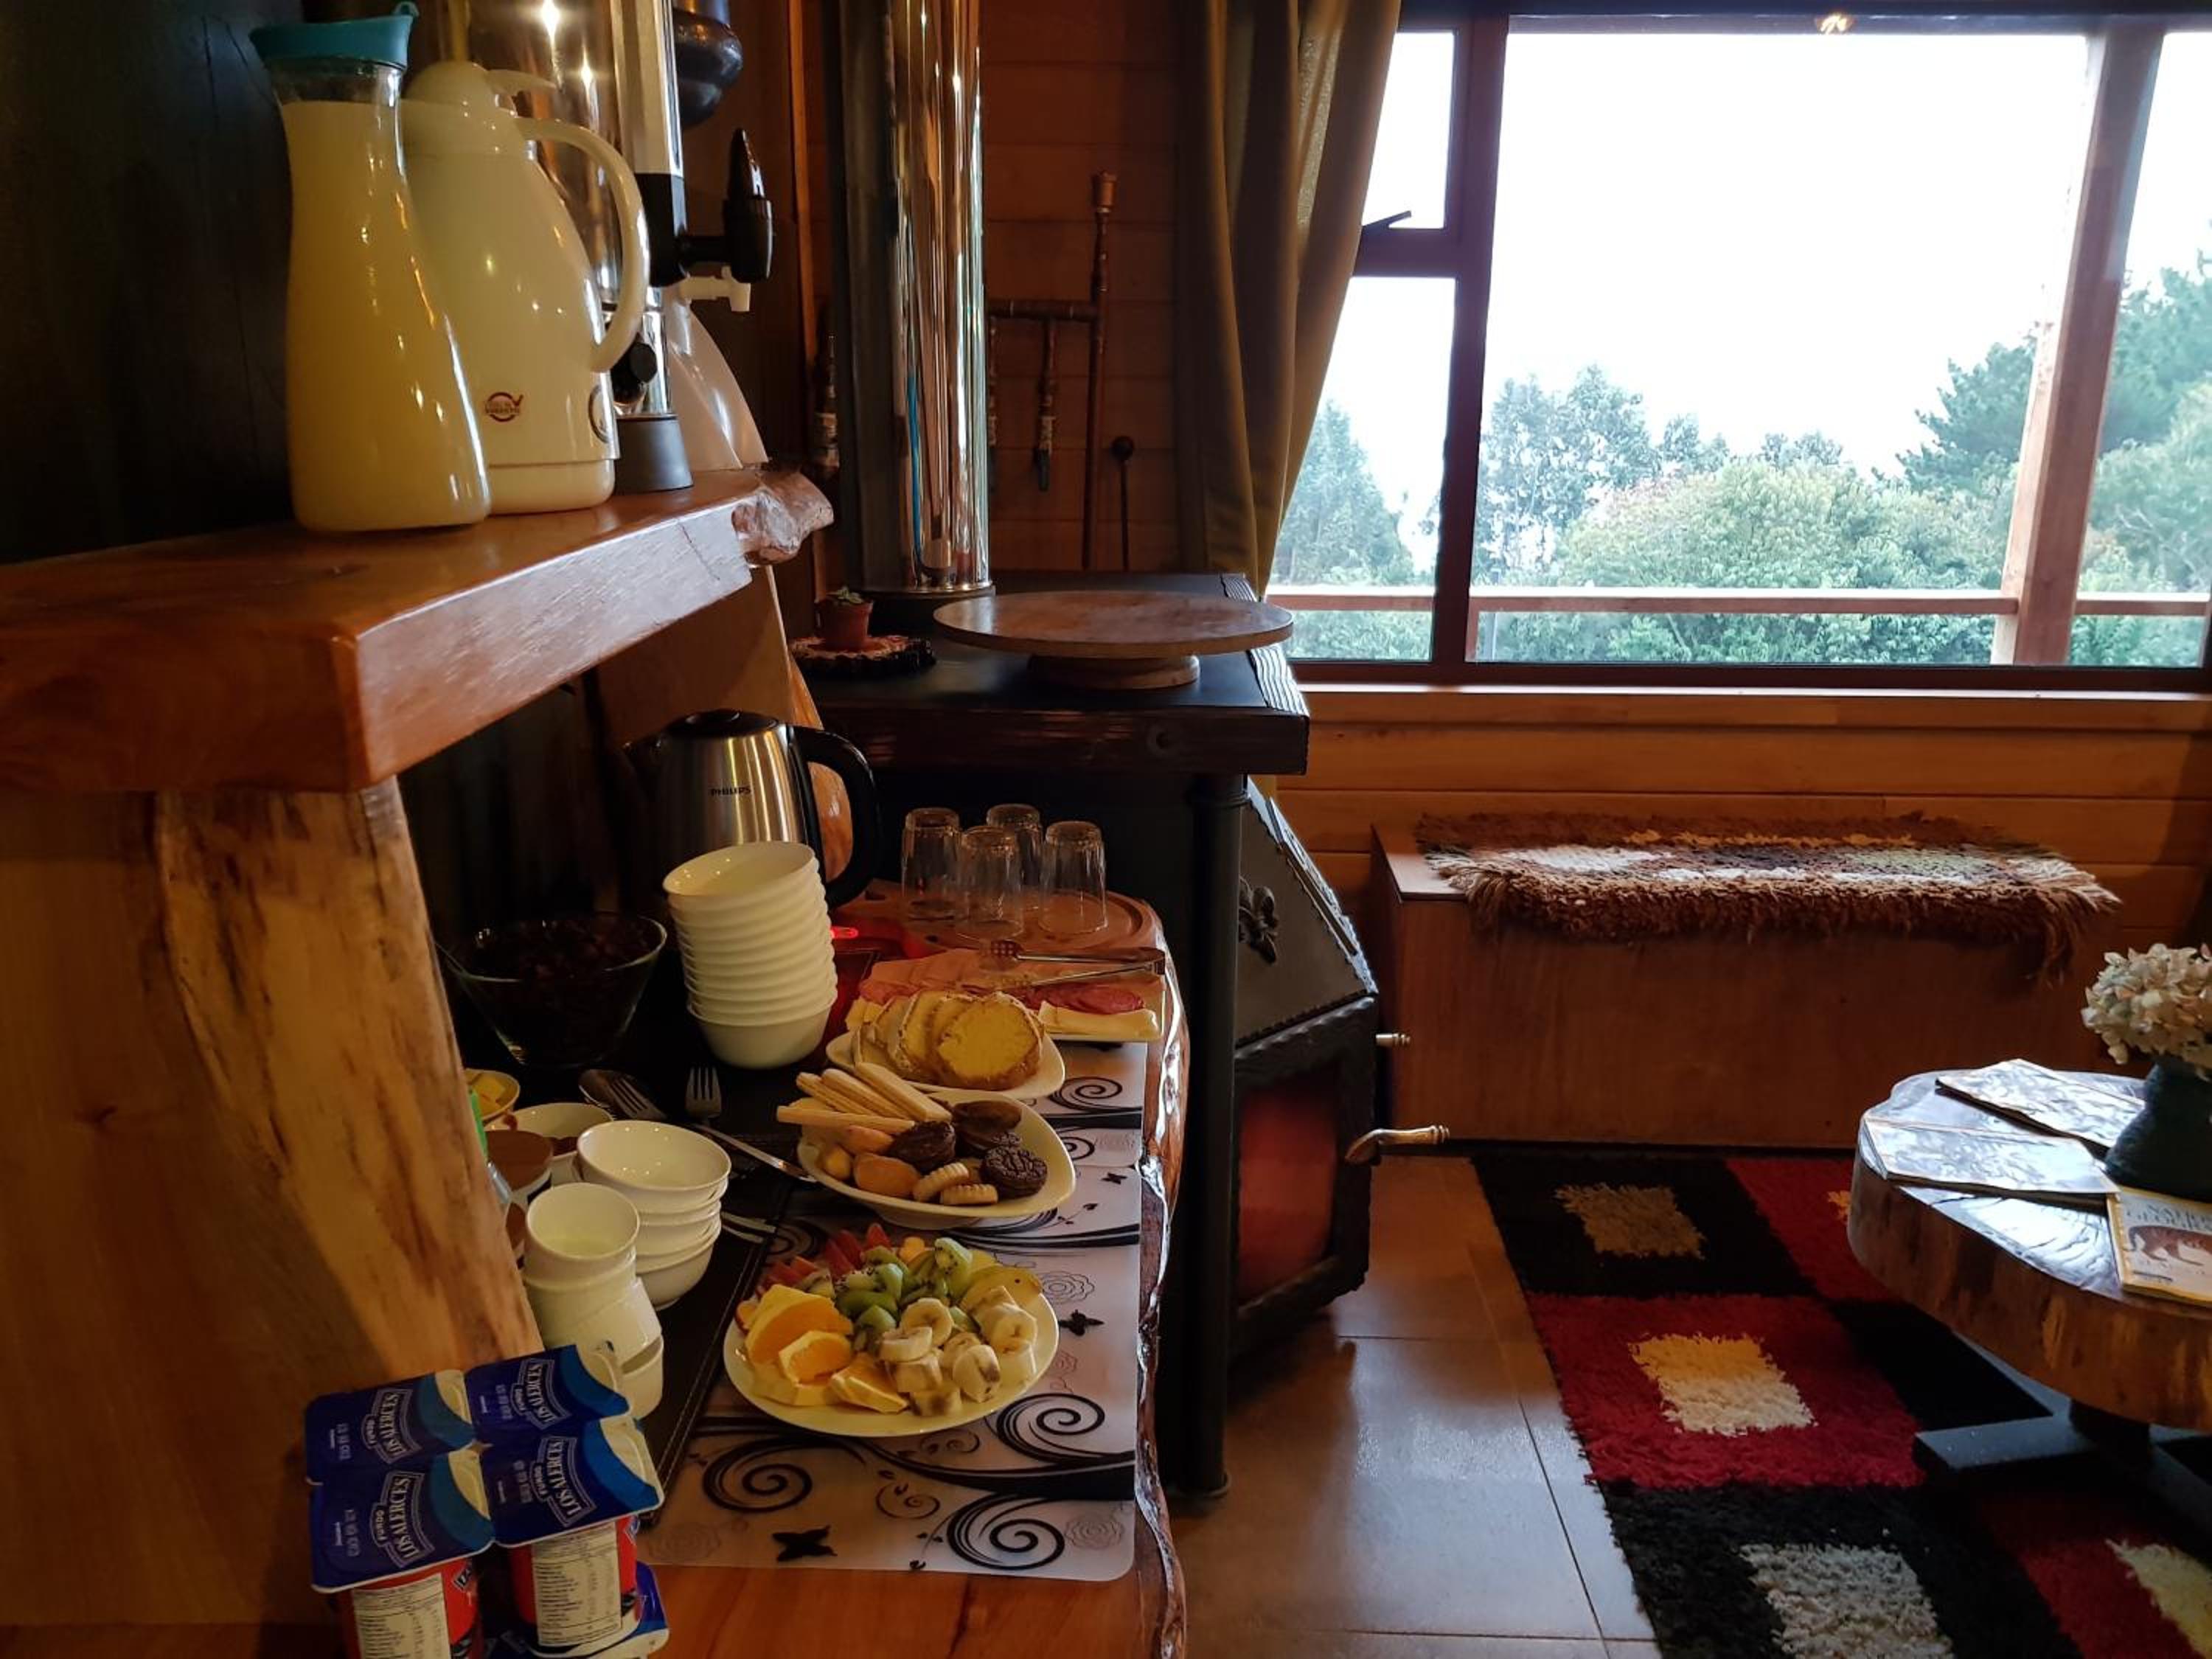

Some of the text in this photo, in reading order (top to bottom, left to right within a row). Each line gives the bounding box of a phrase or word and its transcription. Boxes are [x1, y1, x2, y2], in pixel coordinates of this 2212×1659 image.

[711, 787, 751, 796] PHILIPS
[389, 1478, 411, 1534] ALERCES
[547, 1441, 582, 1515] LOS ALERCES
